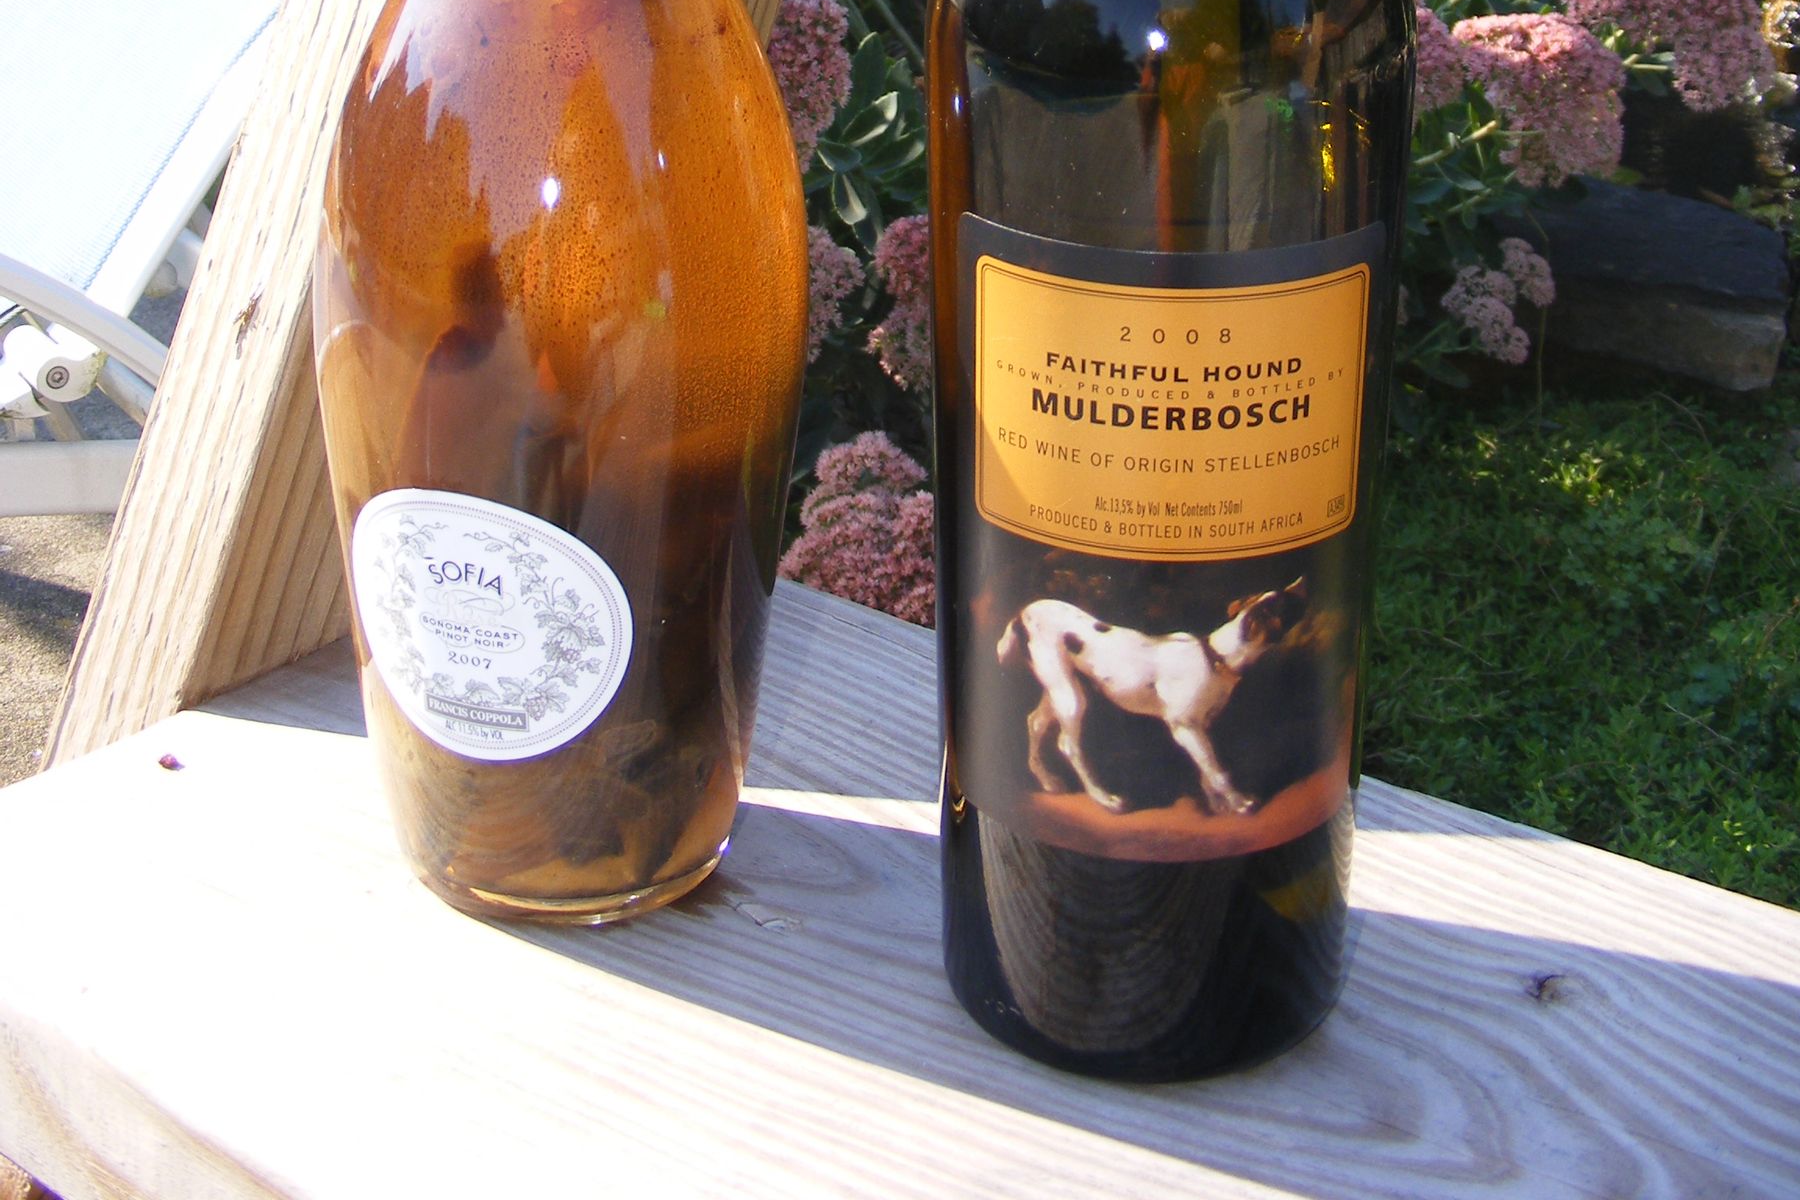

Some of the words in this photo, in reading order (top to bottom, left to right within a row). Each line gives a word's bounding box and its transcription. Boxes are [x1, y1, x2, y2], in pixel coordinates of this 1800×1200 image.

[1046, 351, 1189, 383] FAITHFUL
[1203, 357, 1302, 383] HOUND
[1078, 381, 1190, 401] PRODUCED
[1232, 376, 1316, 398] BOTTLED
[1327, 368, 1344, 381] BY
[1031, 387, 1311, 431] MULDERBOSCH
[998, 426, 1028, 450] RED
[1035, 438, 1081, 465] WINE
[1090, 452, 1114, 469] OF
[1124, 456, 1194, 474] ORIGIN
[1204, 434, 1340, 474] STELLENBOSCH
[1030, 504, 1097, 531] PRODUCED
[1104, 521, 1112, 533] &
[1119, 523, 1182, 538] BOTTLED
[1188, 525, 1202, 538] IN
[1209, 521, 1254, 538] SOUTH
[1261, 512, 1303, 532] AFRICA
[1137, 500, 1146, 518] by
[1148, 501, 1160, 516] Vol
[1165, 502, 1179, 517] Net
[1181, 501, 1216, 517] Contents
[1219, 499, 1243, 516] 750ml
[424, 556, 501, 596] SOFIA
[422, 615, 471, 634] SONOMA
[475, 628, 519, 641] COAST
[435, 628, 468, 643] PINOT
[474, 638, 504, 648] NOIR
[447, 650, 492, 669] 2007
[428, 697, 469, 718] FRANCIS
[470, 709, 524, 726] COPPOLA
